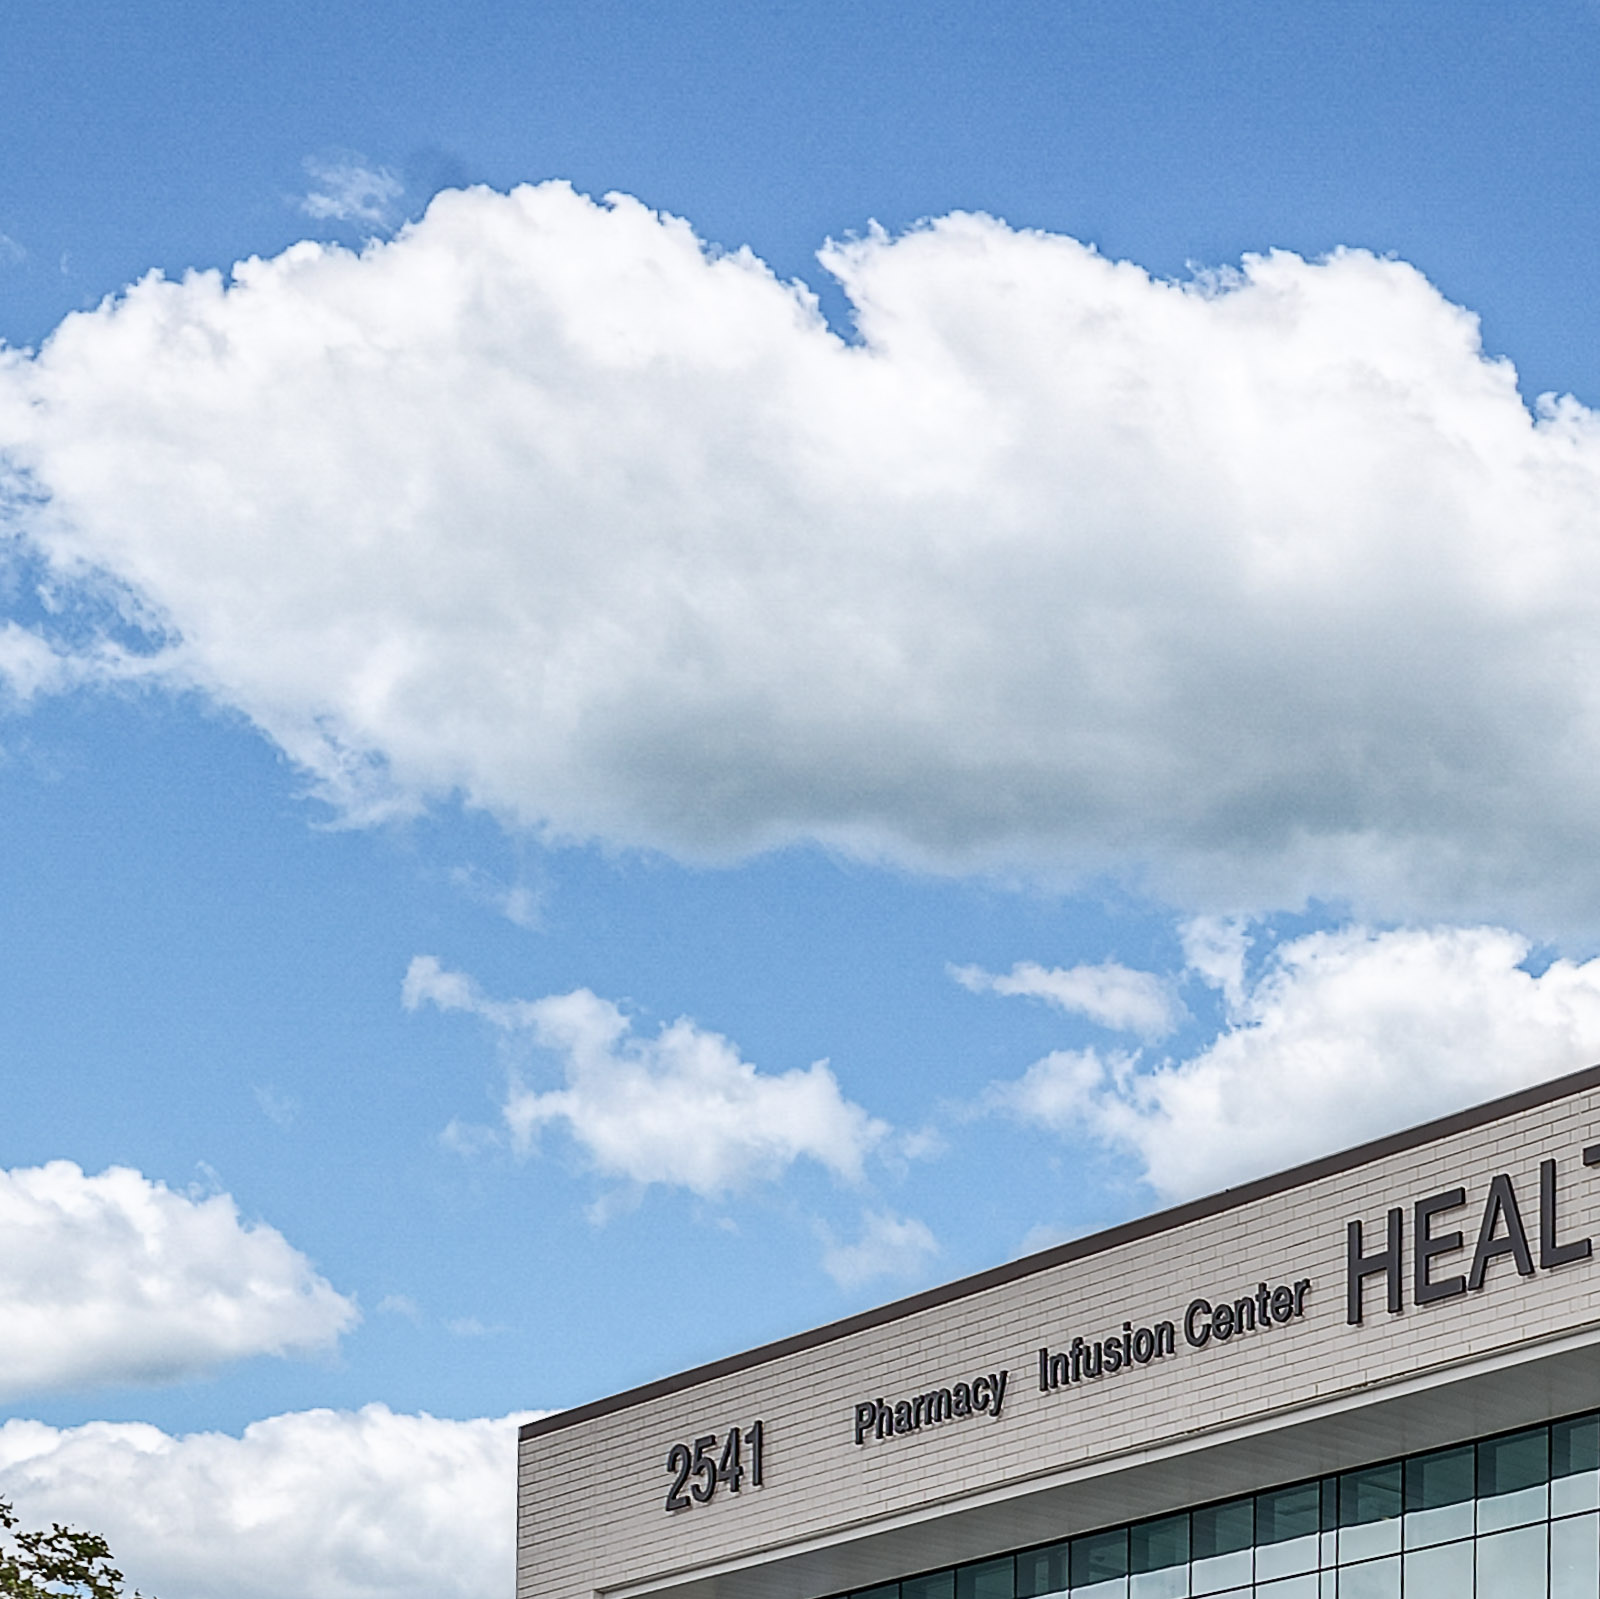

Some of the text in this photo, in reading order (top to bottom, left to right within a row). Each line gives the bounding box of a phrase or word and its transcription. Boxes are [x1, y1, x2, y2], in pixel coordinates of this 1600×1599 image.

[1038, 1279, 1312, 1391] Infusion Center
[854, 1369, 1008, 1445] Pharmacy
[663, 1419, 766, 1511] 2541
